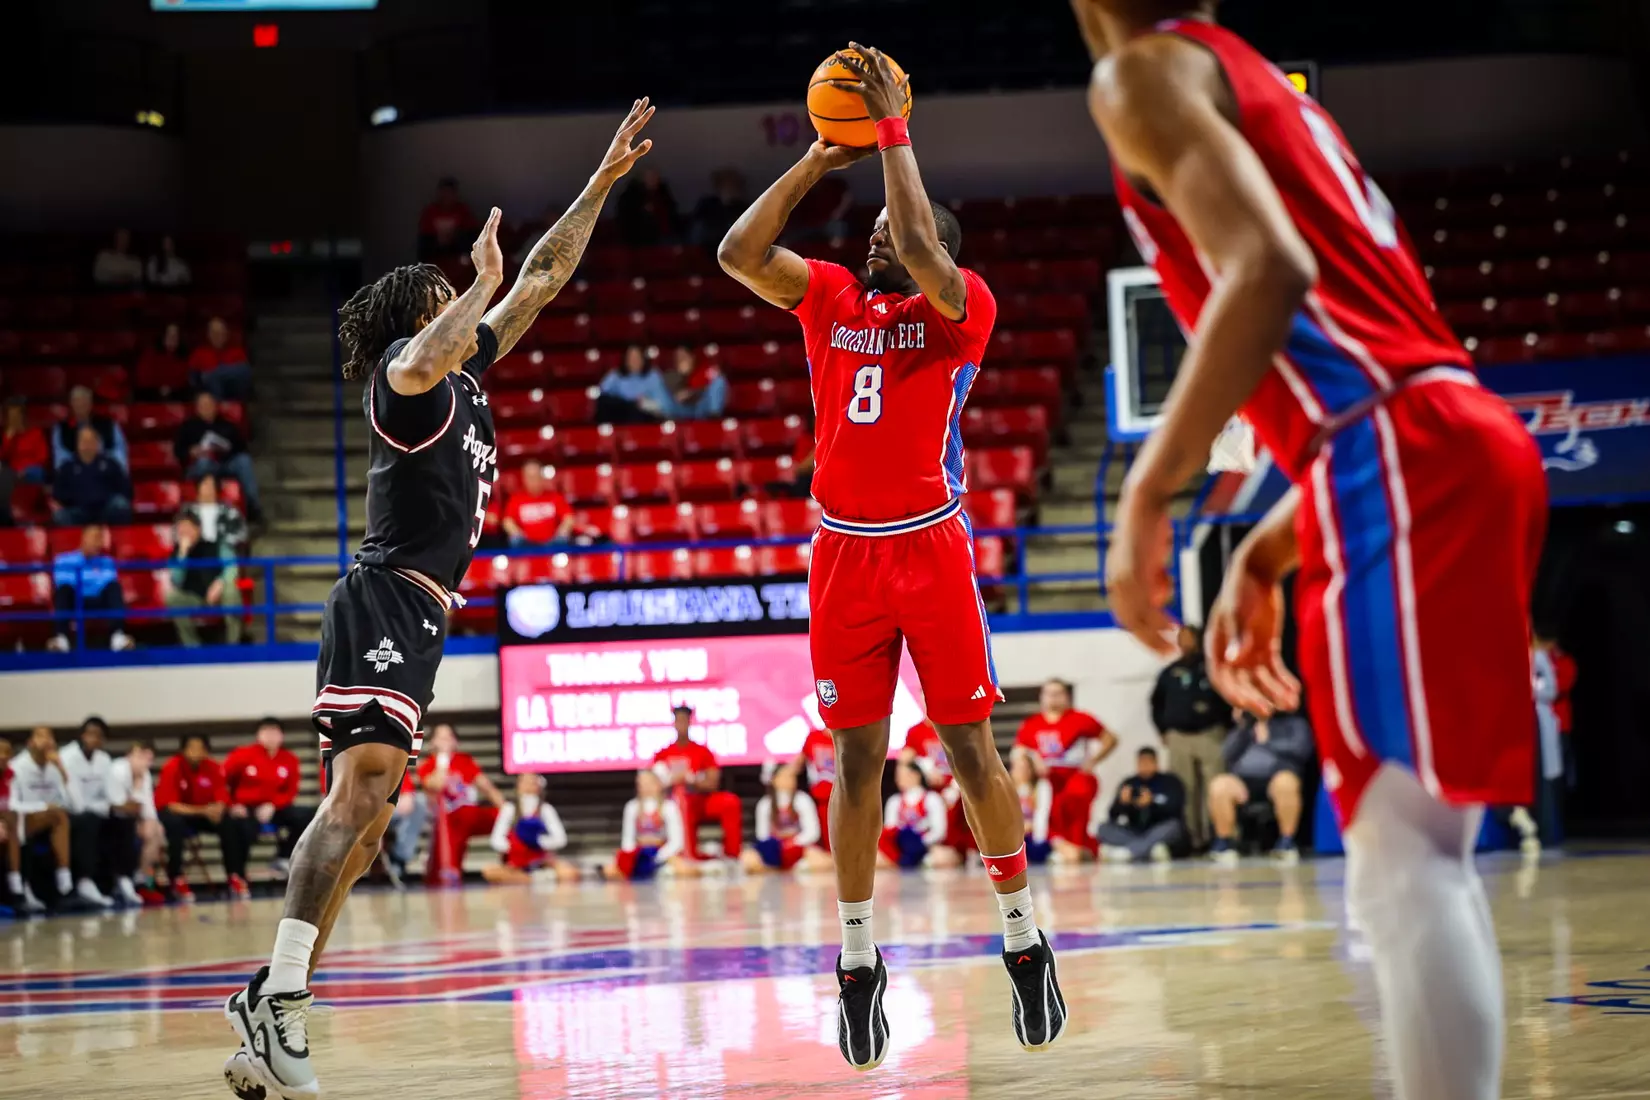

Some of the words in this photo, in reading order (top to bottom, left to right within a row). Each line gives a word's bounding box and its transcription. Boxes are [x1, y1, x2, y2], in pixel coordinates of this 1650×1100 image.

[831, 321, 887, 355] LOUISIAN
[847, 364, 883, 424] 8
[468, 476, 493, 549] 5
